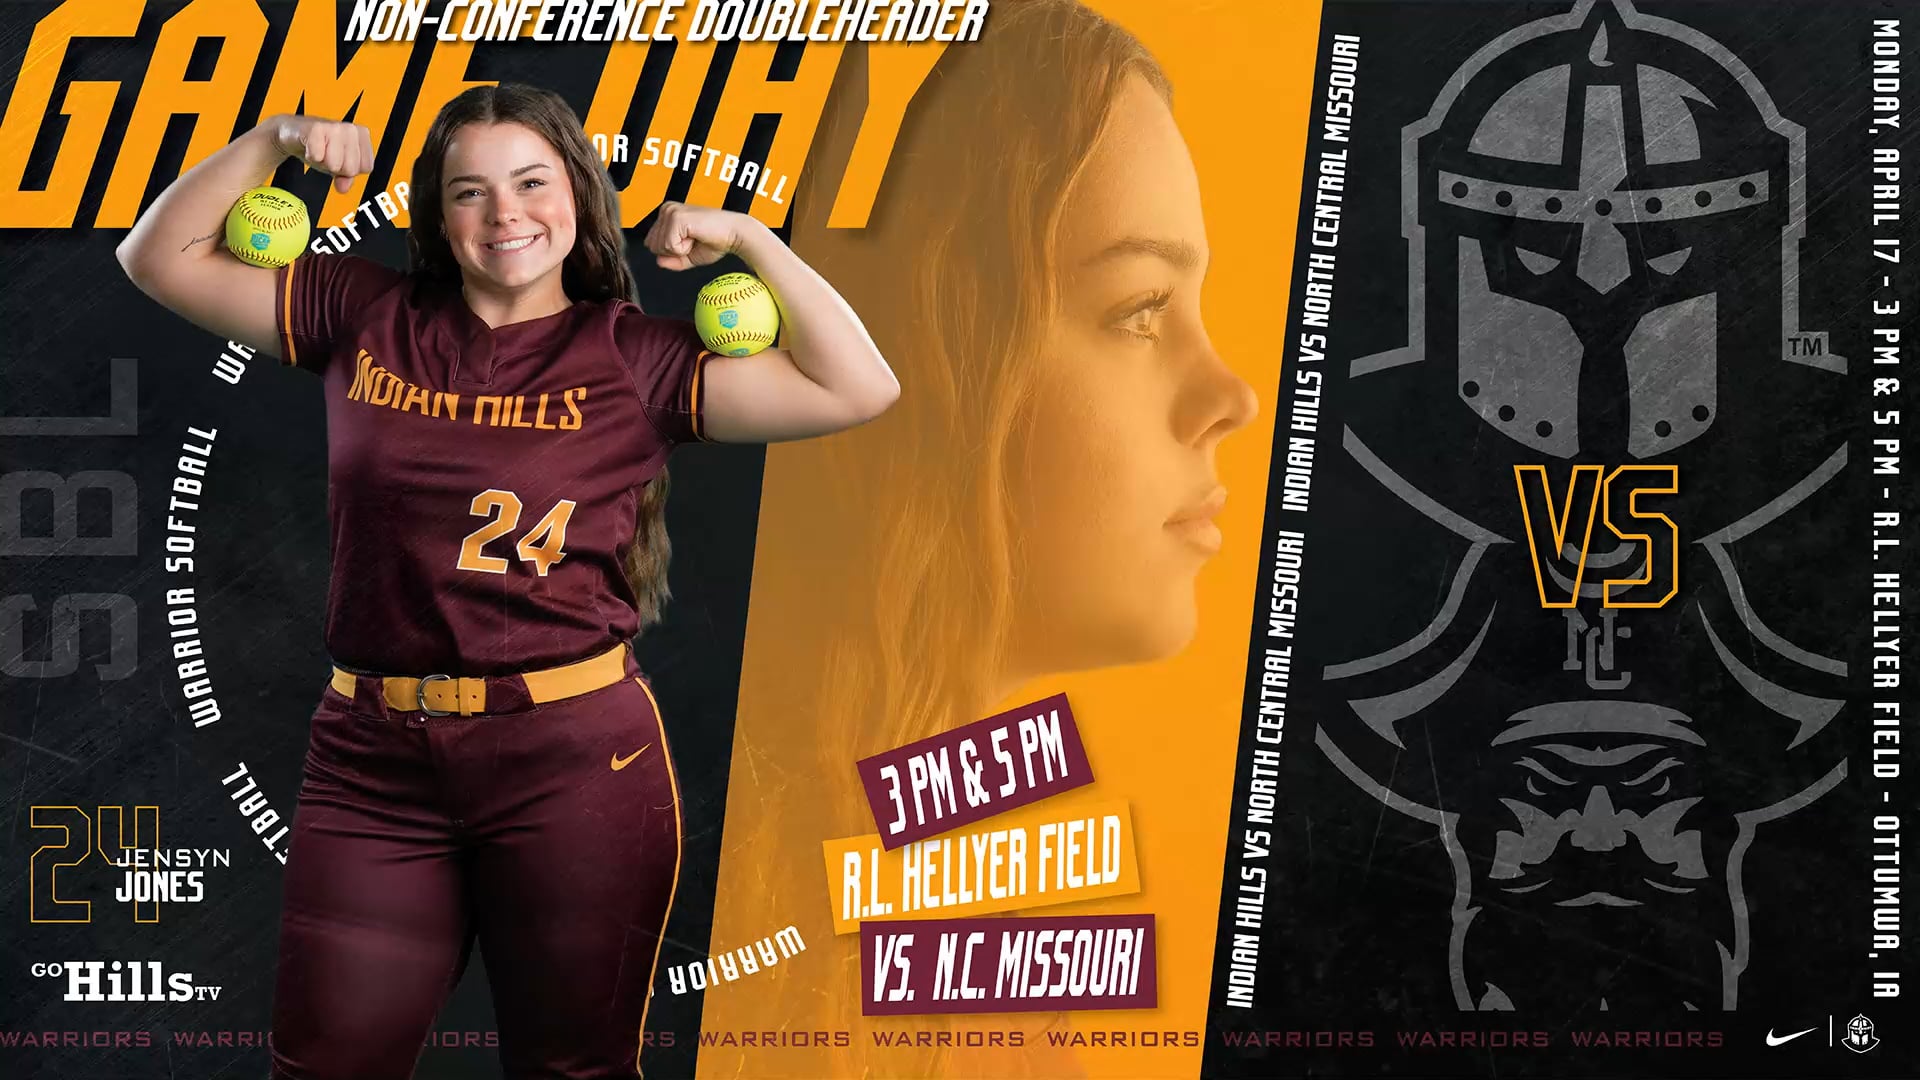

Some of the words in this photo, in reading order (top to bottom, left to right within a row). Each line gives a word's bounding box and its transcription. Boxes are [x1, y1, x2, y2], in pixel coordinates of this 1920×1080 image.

[347, 349, 459, 421] INDIAN
[473, 387, 587, 430] HILLS
[456, 488, 577, 577] 24
